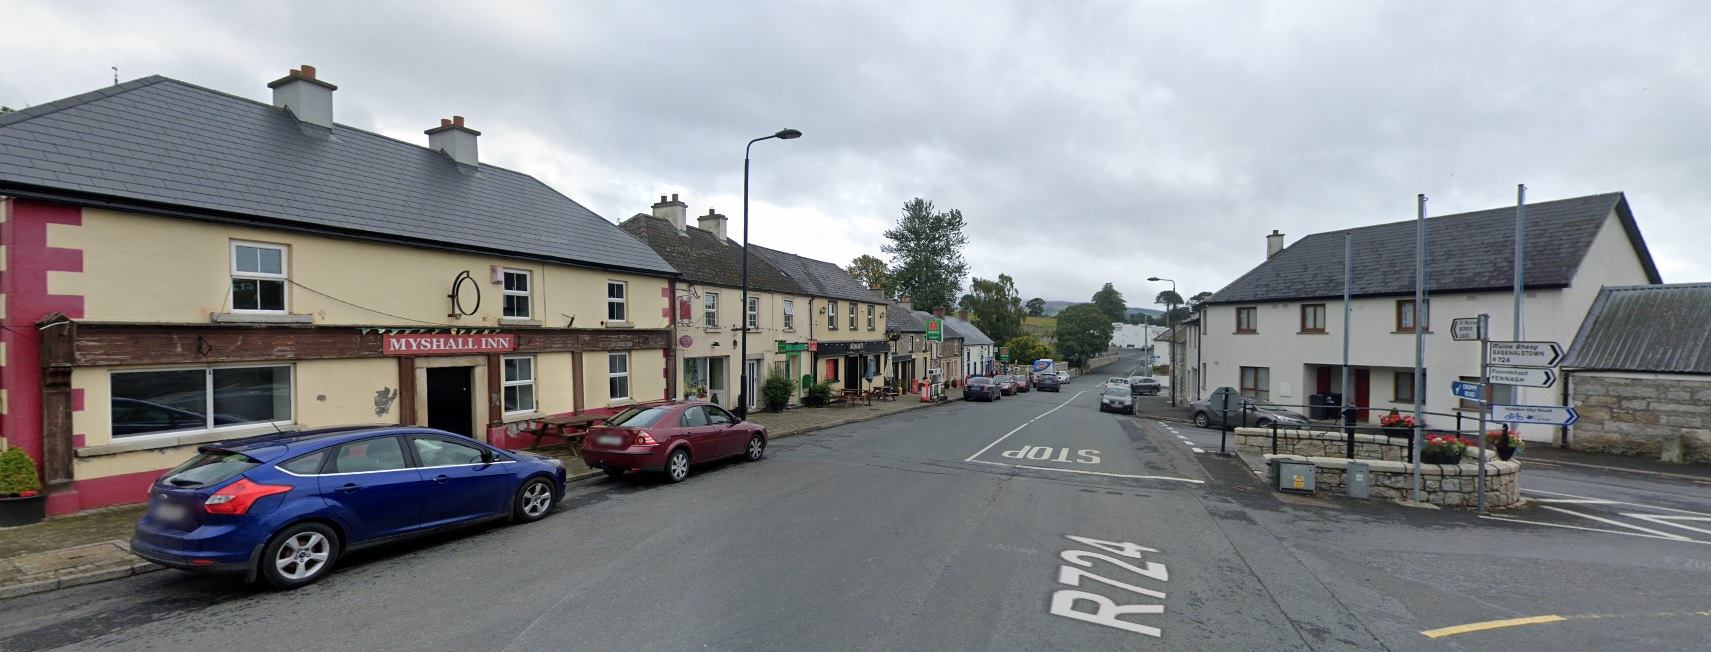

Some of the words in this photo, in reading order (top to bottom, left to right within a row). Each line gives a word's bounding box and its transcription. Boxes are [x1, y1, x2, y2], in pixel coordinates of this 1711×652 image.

[389, 337, 478, 351] MYSHALL
[480, 337, 510, 349] INN
[1001, 445, 1101, 464] STOP
[1049, 534, 1170, 638] R724
